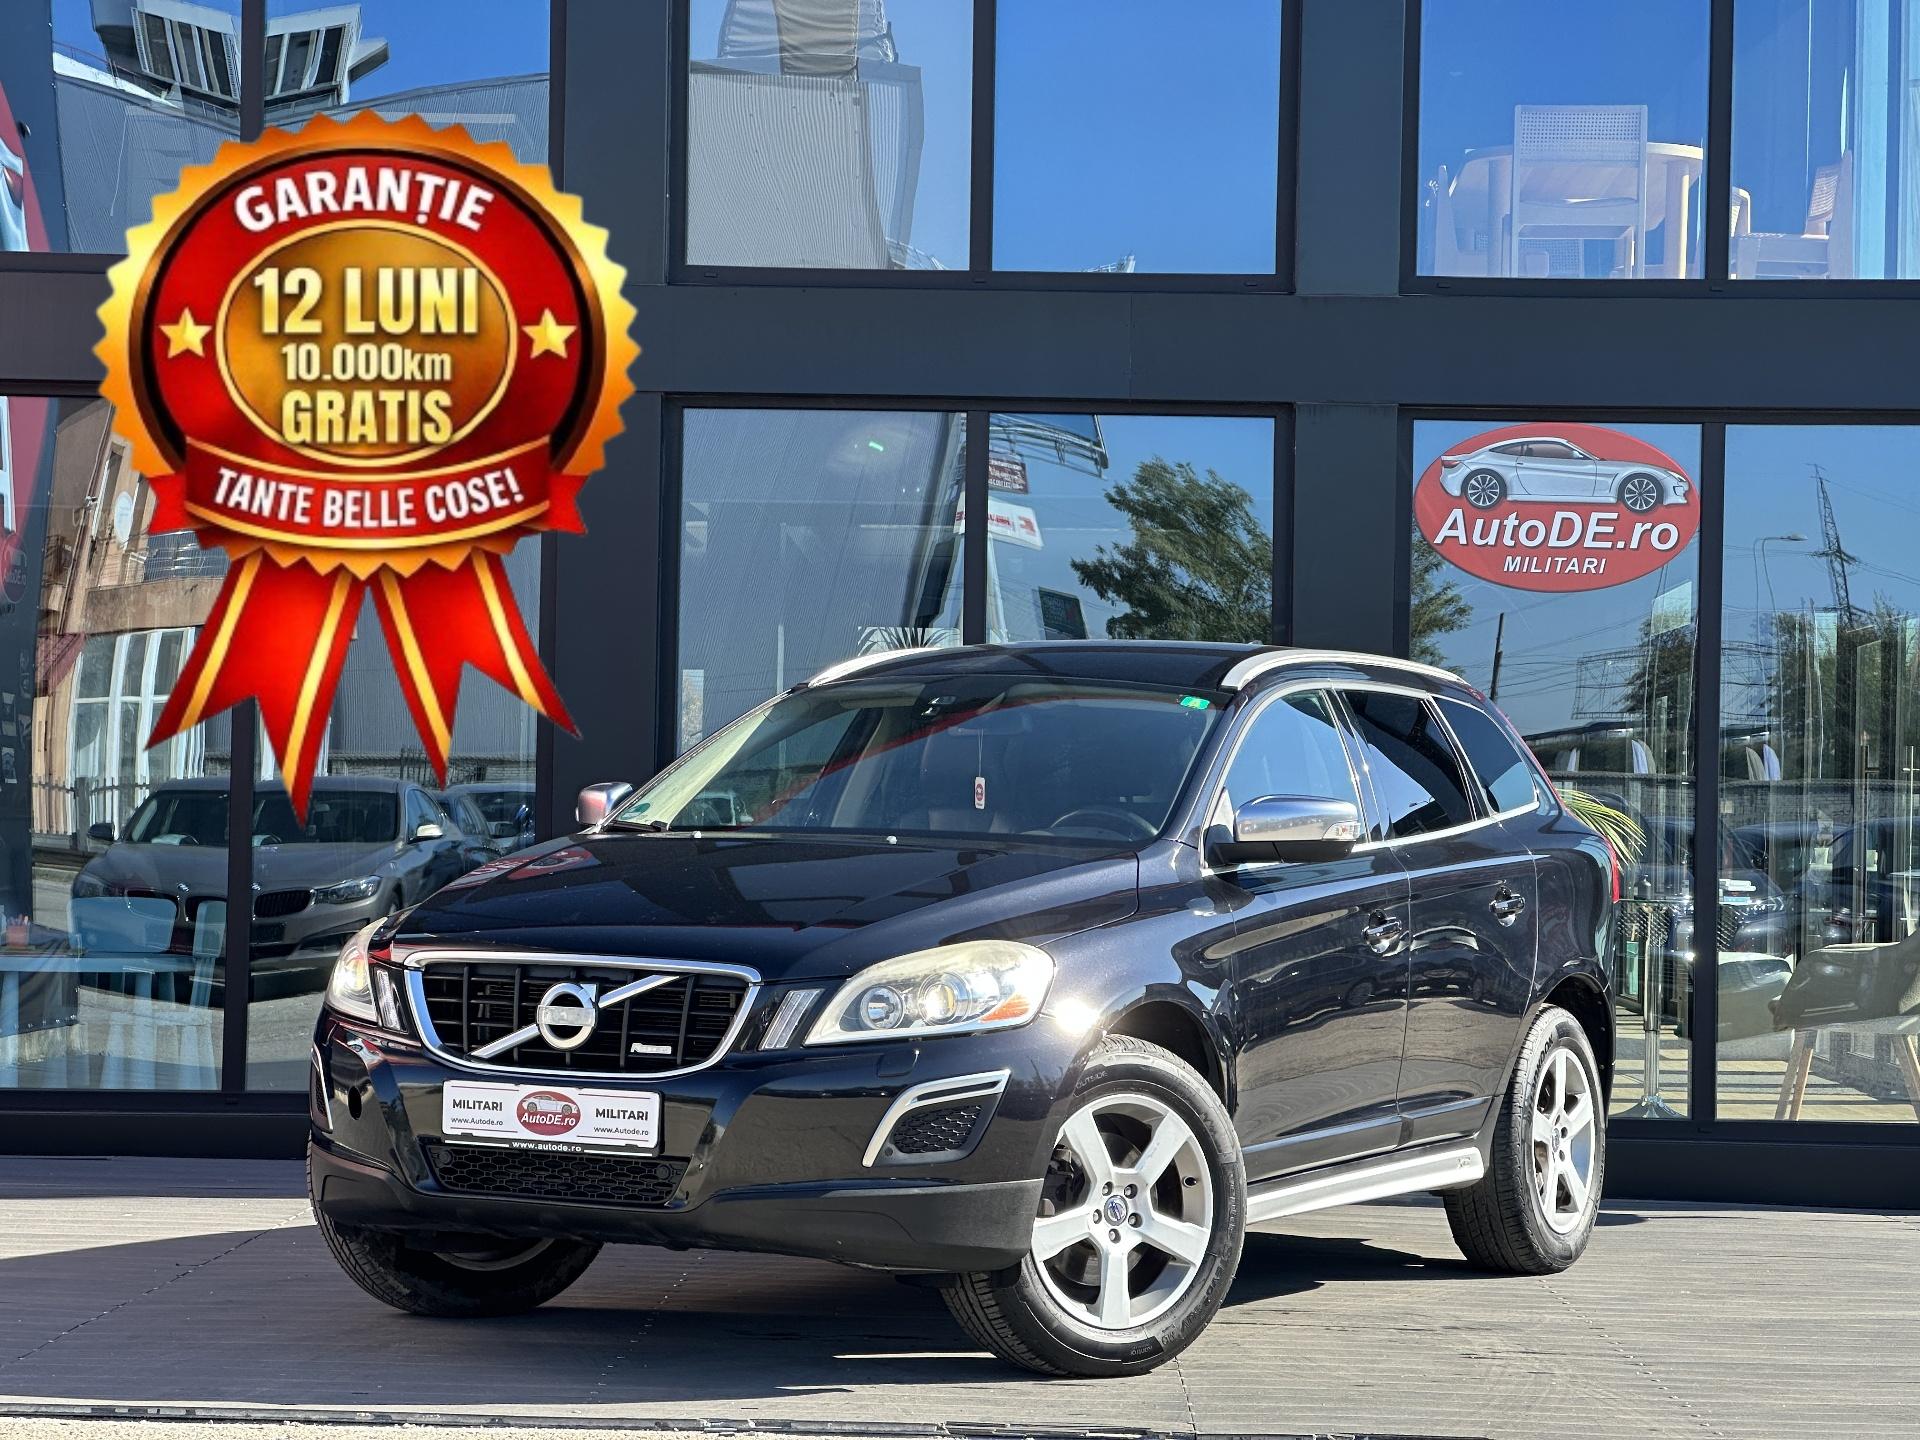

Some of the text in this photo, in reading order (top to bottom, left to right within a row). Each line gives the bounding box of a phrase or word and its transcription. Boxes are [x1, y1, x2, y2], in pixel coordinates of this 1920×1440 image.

[1434, 508, 1679, 551] AutoDE.ro
[1503, 556, 1606, 575] MILITARI
[452, 1098, 503, 1112] MILITARI
[520, 1113, 576, 1127] AutoDE.ro
[595, 1107, 649, 1121] MILITARI
[451, 1117, 504, 1126] www.Autode.ro
[593, 1126, 649, 1136] www.Autode.ro
[512, 1140, 582, 1152] www.autode.ro
